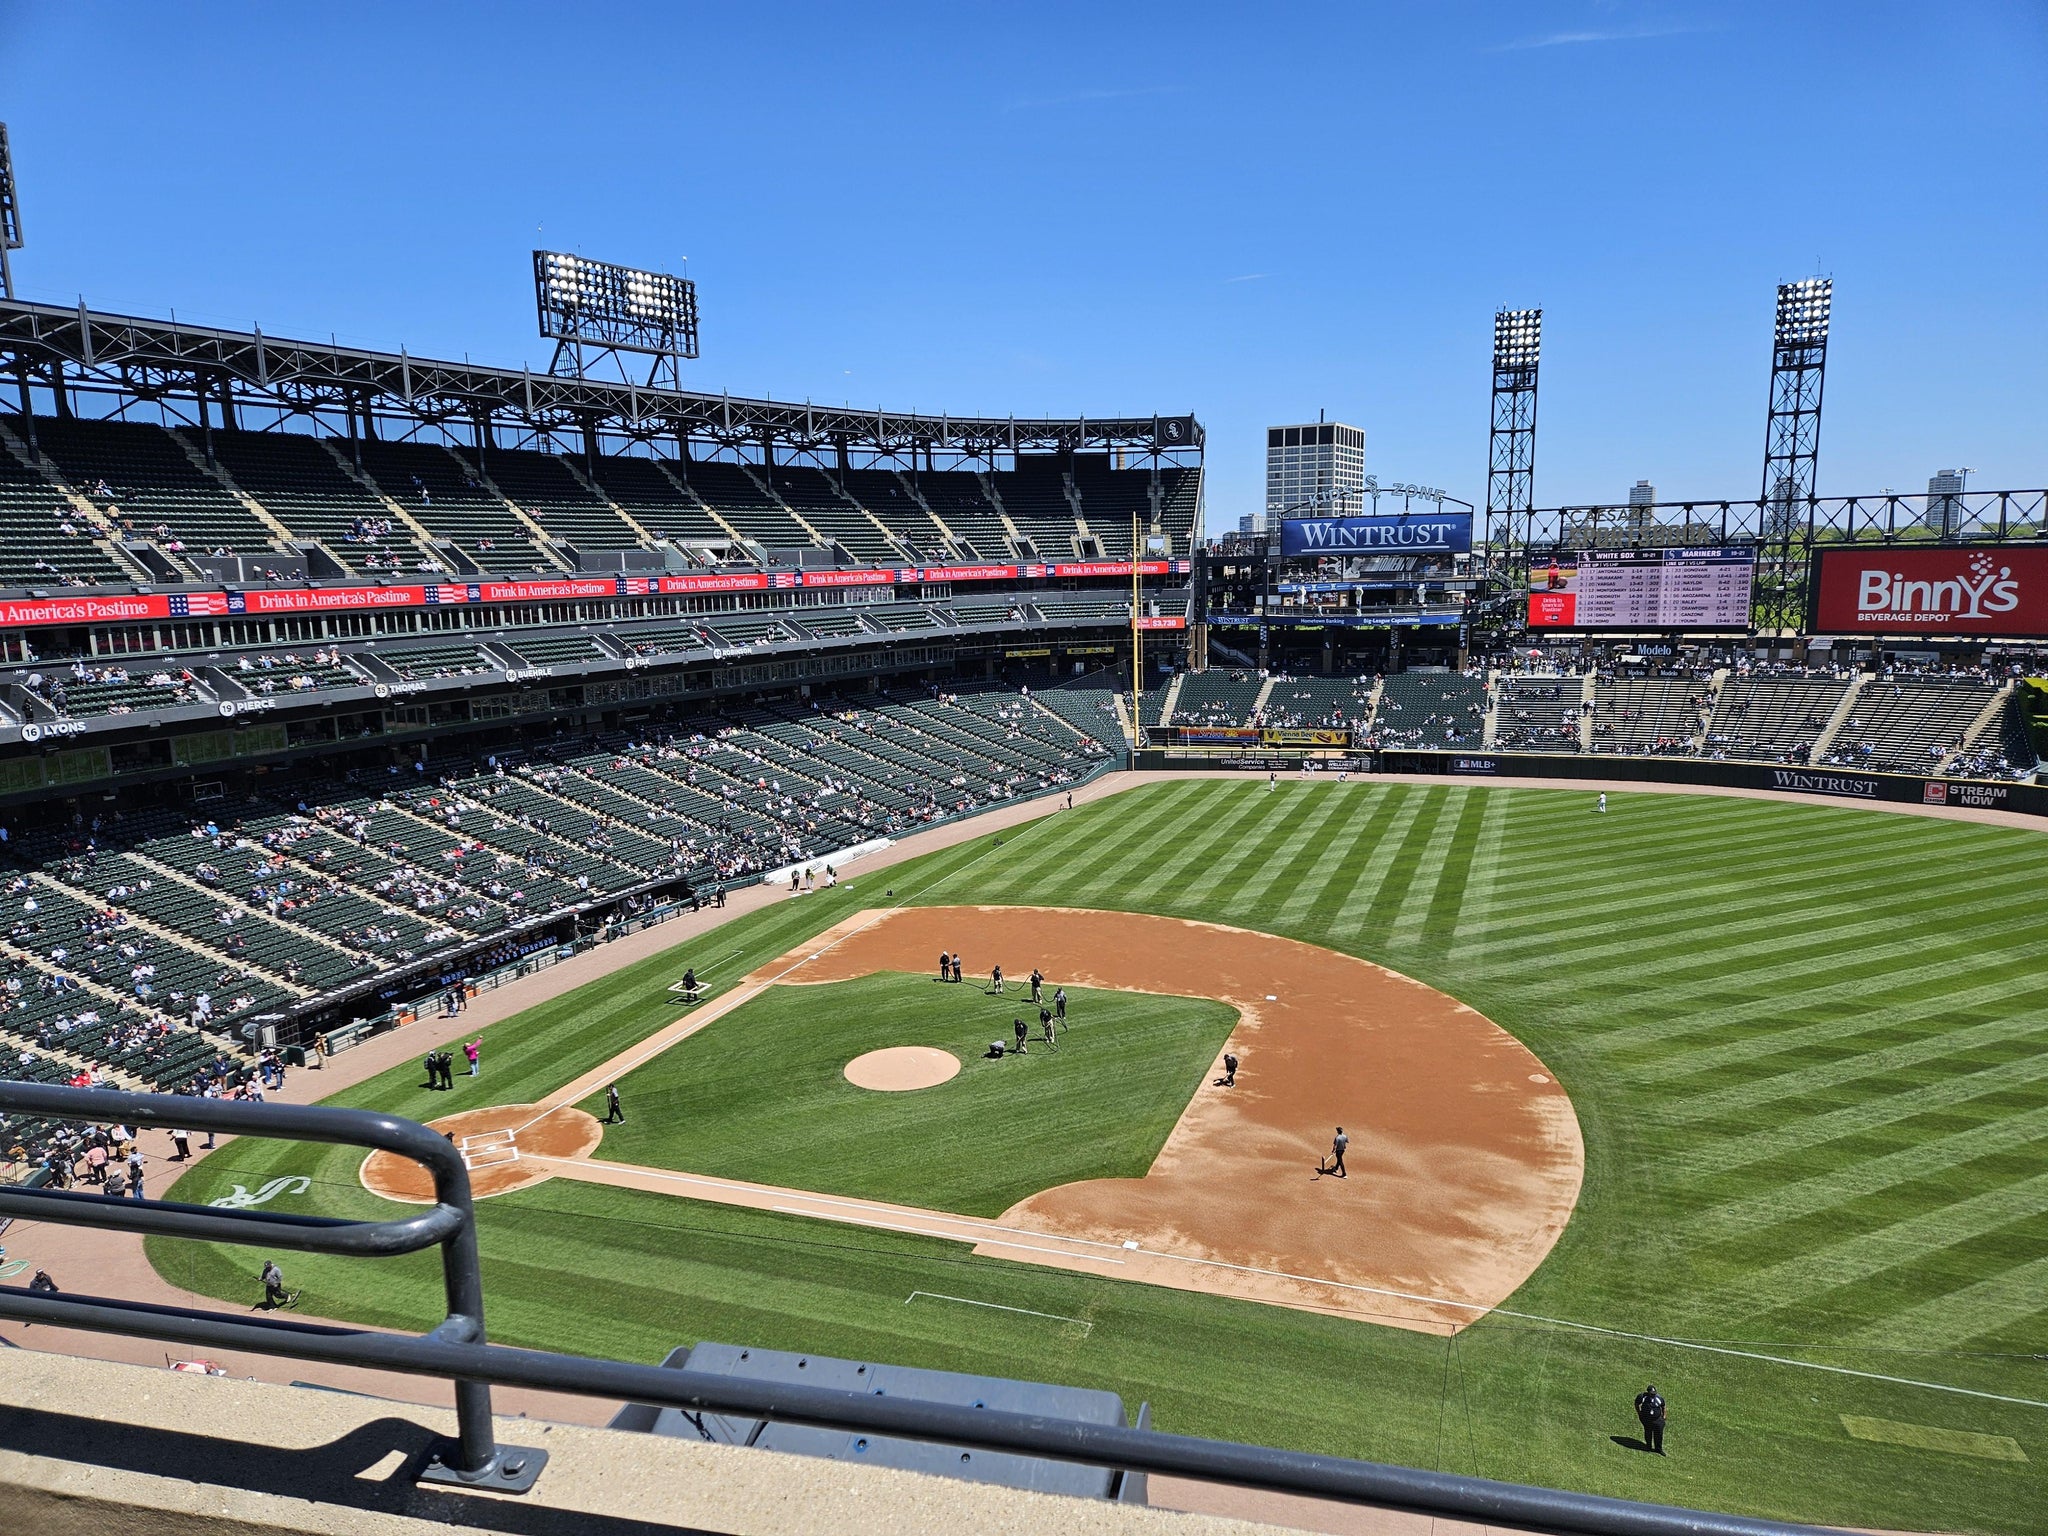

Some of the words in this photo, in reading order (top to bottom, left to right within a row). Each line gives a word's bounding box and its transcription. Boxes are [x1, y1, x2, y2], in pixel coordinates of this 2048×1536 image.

[1309, 486, 1353, 507] KIDS
[1391, 483, 1446, 503] ZONE
[1571, 508, 1653, 522] CAESARS
[1301, 522, 1451, 546] WINTRUST
[1569, 524, 1712, 547] SPORTSBOOK
[952, 568, 982, 578] America's
[983, 568, 1008, 576] Pastime
[1063, 565, 1082, 574] Drink
[1092, 564, 1125, 573] America's
[1126, 563, 1158, 572] Pstime
[666, 580, 687, 590] Drink
[696, 578, 730, 588] America's
[730, 577, 758, 587] Pastime
[809, 575, 826, 584] Drink
[834, 574, 862, 583] America's
[862, 572, 886, 582] Pastime
[491, 587, 517, 598] Drink
[518, 586, 527, 597] in
[528, 584, 570, 596] America's
[571, 583, 605, 594] Pastime
[228, 600, 244, 609] 250
[260, 594, 292, 609] Drink
[293, 593, 304, 607] in
[304, 591, 366, 606] America's
[366, 590, 410, 604] Pastime
[7, 604, 83, 622] America's
[87, 601, 148, 617] Pastime
[1858, 613, 1912, 622] BEVERAGE
[1914, 614, 1950, 622] DEPOT
[1392, 616, 1420, 624] Capabilities
[1638, 644, 1672, 656] Modelo
[636, 658, 650, 666] FISK
[518, 668, 552, 680] BUEHRLE
[377, 686, 386, 695] 35
[389, 682, 427, 694] THOMAS
[222, 704, 232, 713] 19
[236, 698, 276, 713] PIERCE
[26, 728, 38, 738] 16
[43, 722, 87, 737] LYONS
[1277, 730, 1300, 738] Vienna
[1774, 770, 1877, 794] WINTRUST
[1949, 785, 2007, 798] STREAM
[1961, 794, 1994, 806] NOW
